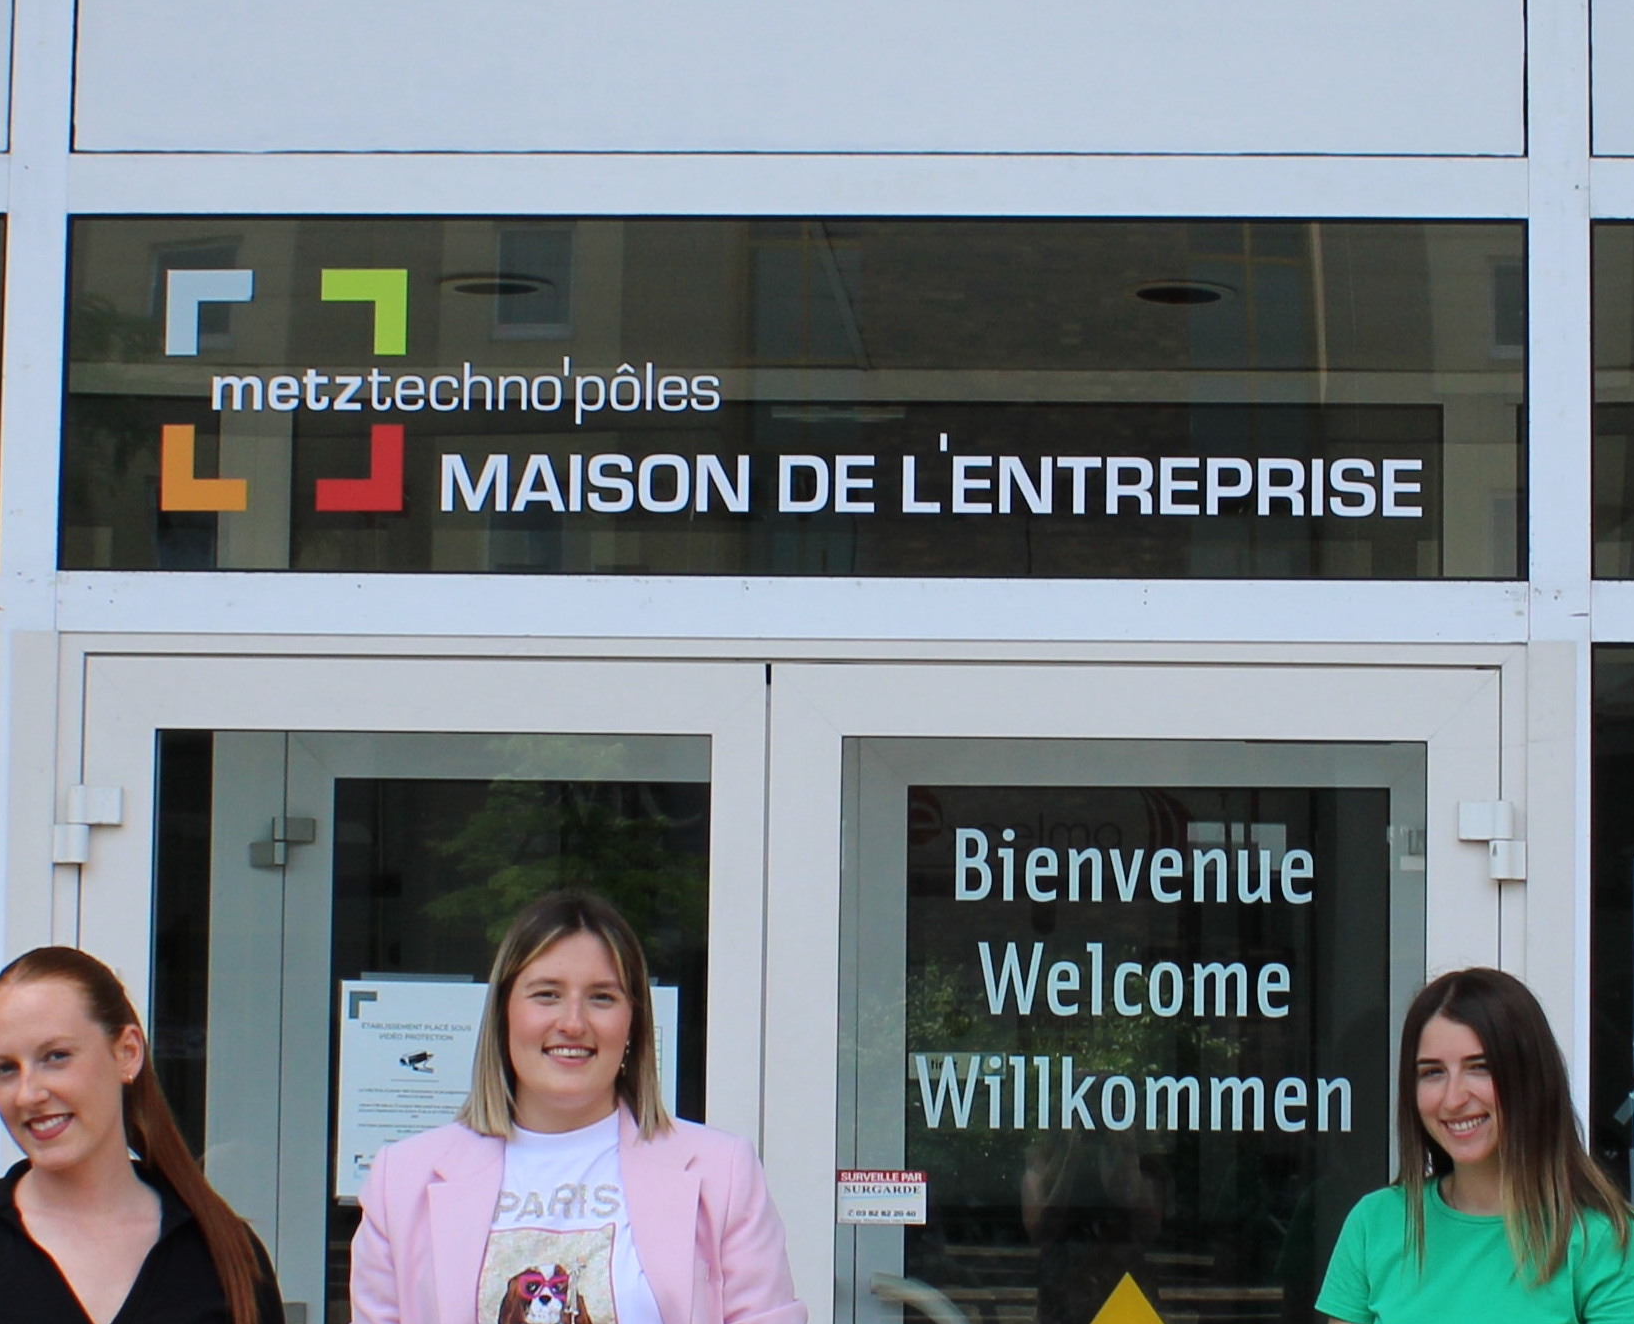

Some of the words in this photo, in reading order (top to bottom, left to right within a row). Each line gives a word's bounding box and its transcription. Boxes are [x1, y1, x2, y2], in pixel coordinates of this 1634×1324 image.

[440, 454, 750, 511] MAISON
[778, 455, 875, 512] DE
[902, 432, 1423, 517] L'ENTREPRISE
[955, 828, 1314, 904] Bienvenue
[978, 941, 1291, 1018] Welcome
[405, 1032, 454, 1041] PROTECTION
[914, 1055, 1352, 1133] Willkommen
[492, 1182, 621, 1224] PARIS
[843, 1184, 921, 1195] SURGARDE
[901, 1172, 922, 1182] PAR
